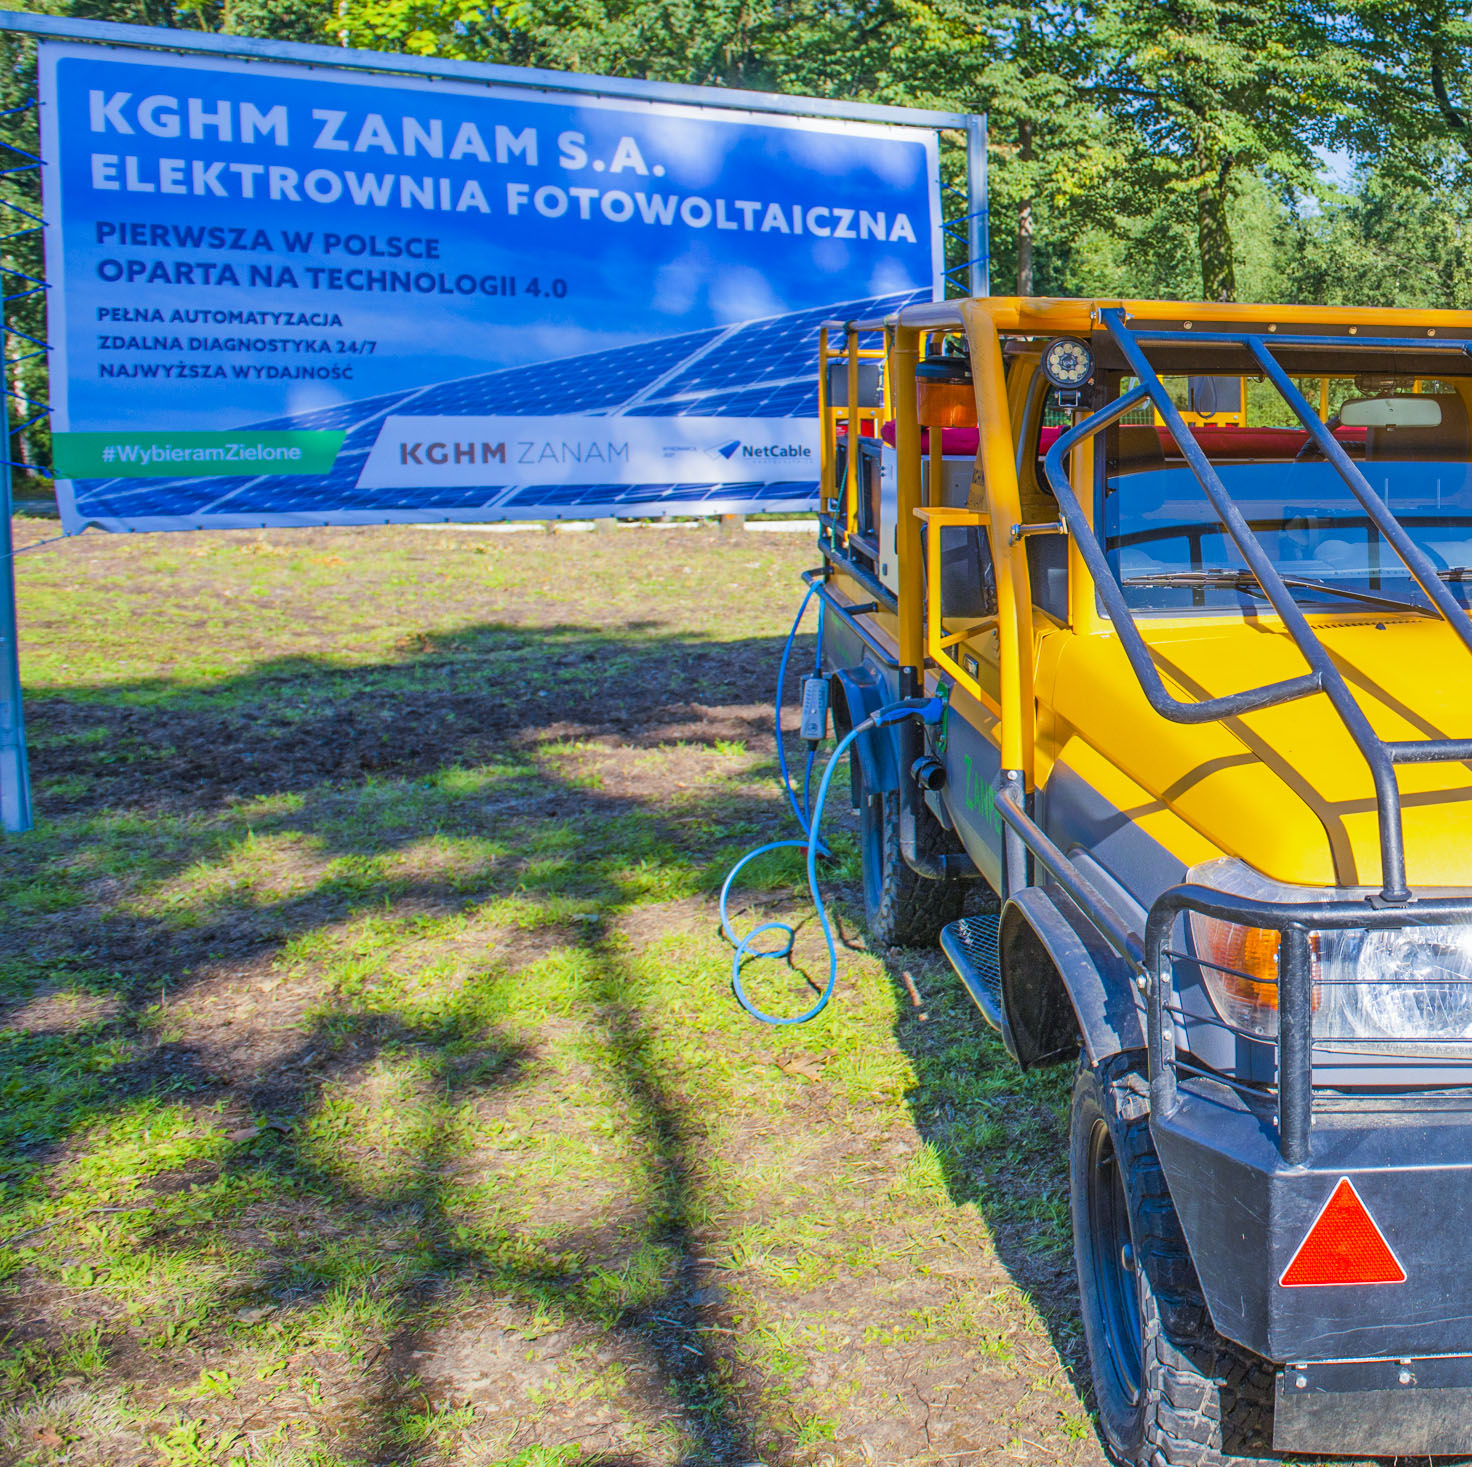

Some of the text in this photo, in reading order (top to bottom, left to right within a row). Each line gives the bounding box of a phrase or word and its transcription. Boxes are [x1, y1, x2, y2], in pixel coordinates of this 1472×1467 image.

[89, 89, 666, 177] KGHM ZANAM S.A.
[91, 153, 917, 244] ELEKTROWNIA FOTOWOLTAICZNA
[96, 220, 440, 260] PIERWSZA W POLSCE
[97, 258, 567, 298] OPARTA NA TECHNOLOGII 4.0
[97, 307, 343, 327] PEŁNA AUTOMATYZACJA
[98, 335, 376, 355] ZDALNA DIAGNOSTYKA 24/7
[99, 360, 353, 380] NAJWYŻSZA WYDAJNOŚĆ
[102, 443, 301, 465] #WybieramZielone
[400, 441, 630, 465] KGHM ZANAM
[743, 445, 811, 458] NetCable
